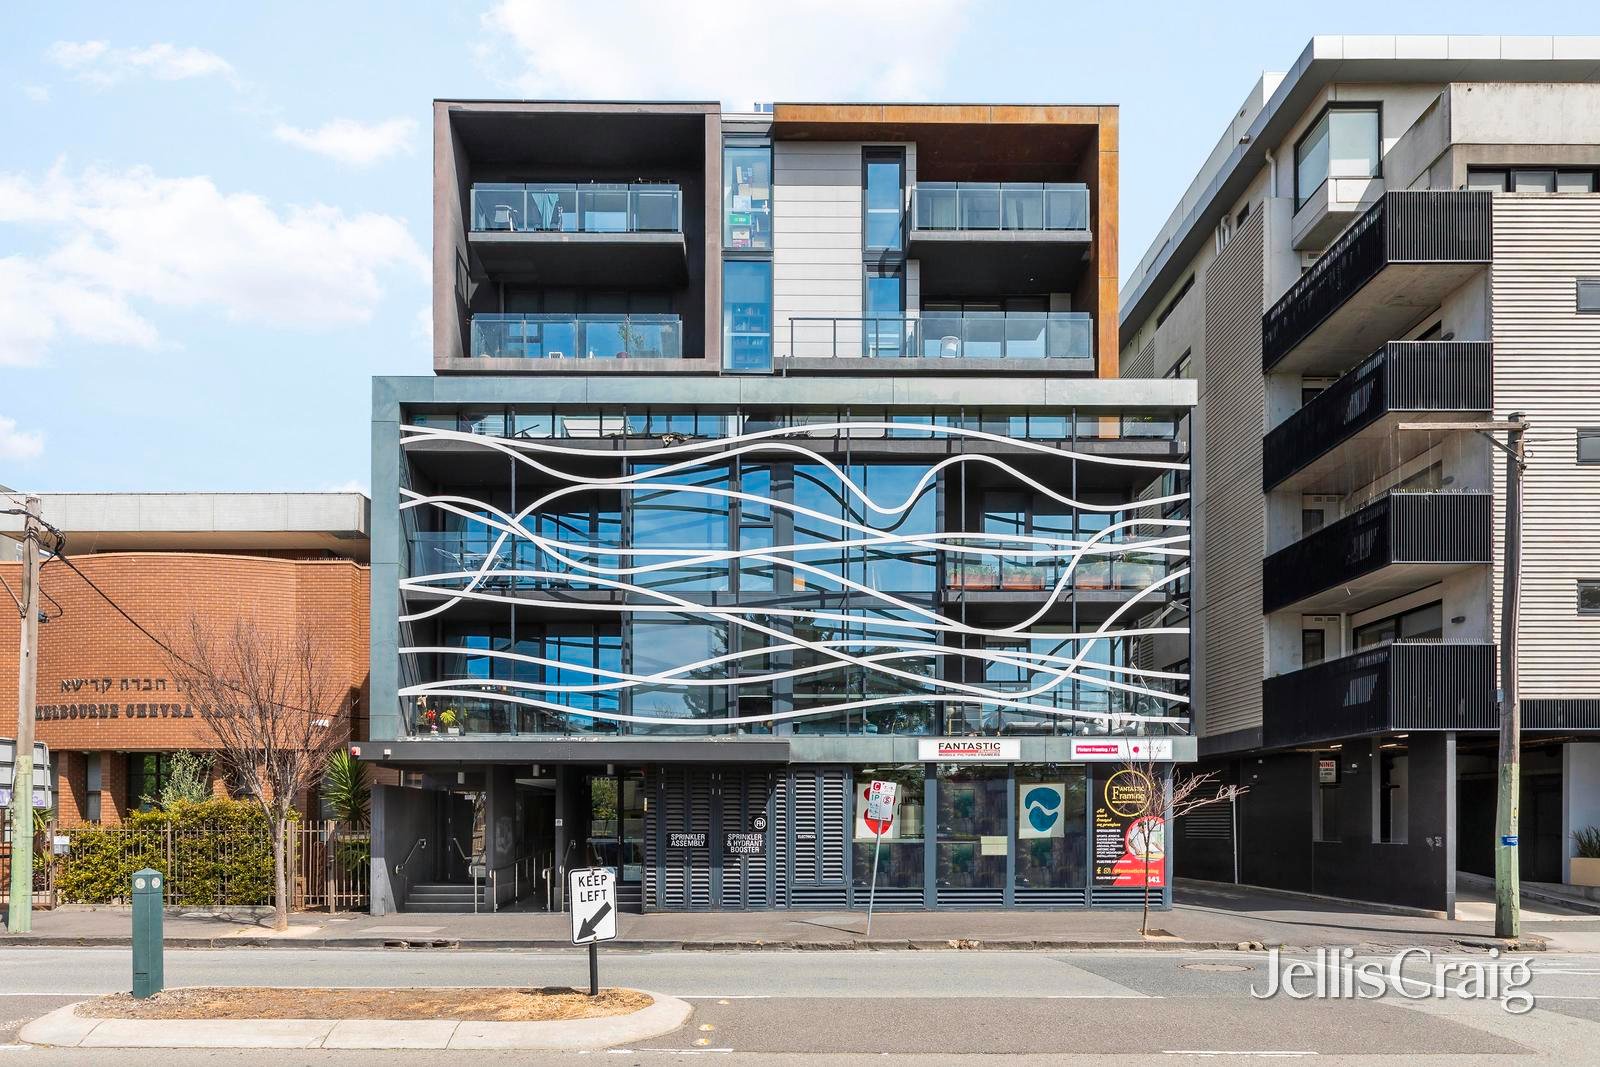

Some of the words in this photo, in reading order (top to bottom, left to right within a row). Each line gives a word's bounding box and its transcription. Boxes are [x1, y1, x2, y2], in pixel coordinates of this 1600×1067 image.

[938, 742, 1001, 750] FANTASTIC
[578, 874, 608, 888] KEEP
[580, 889, 607, 902] LEFT
